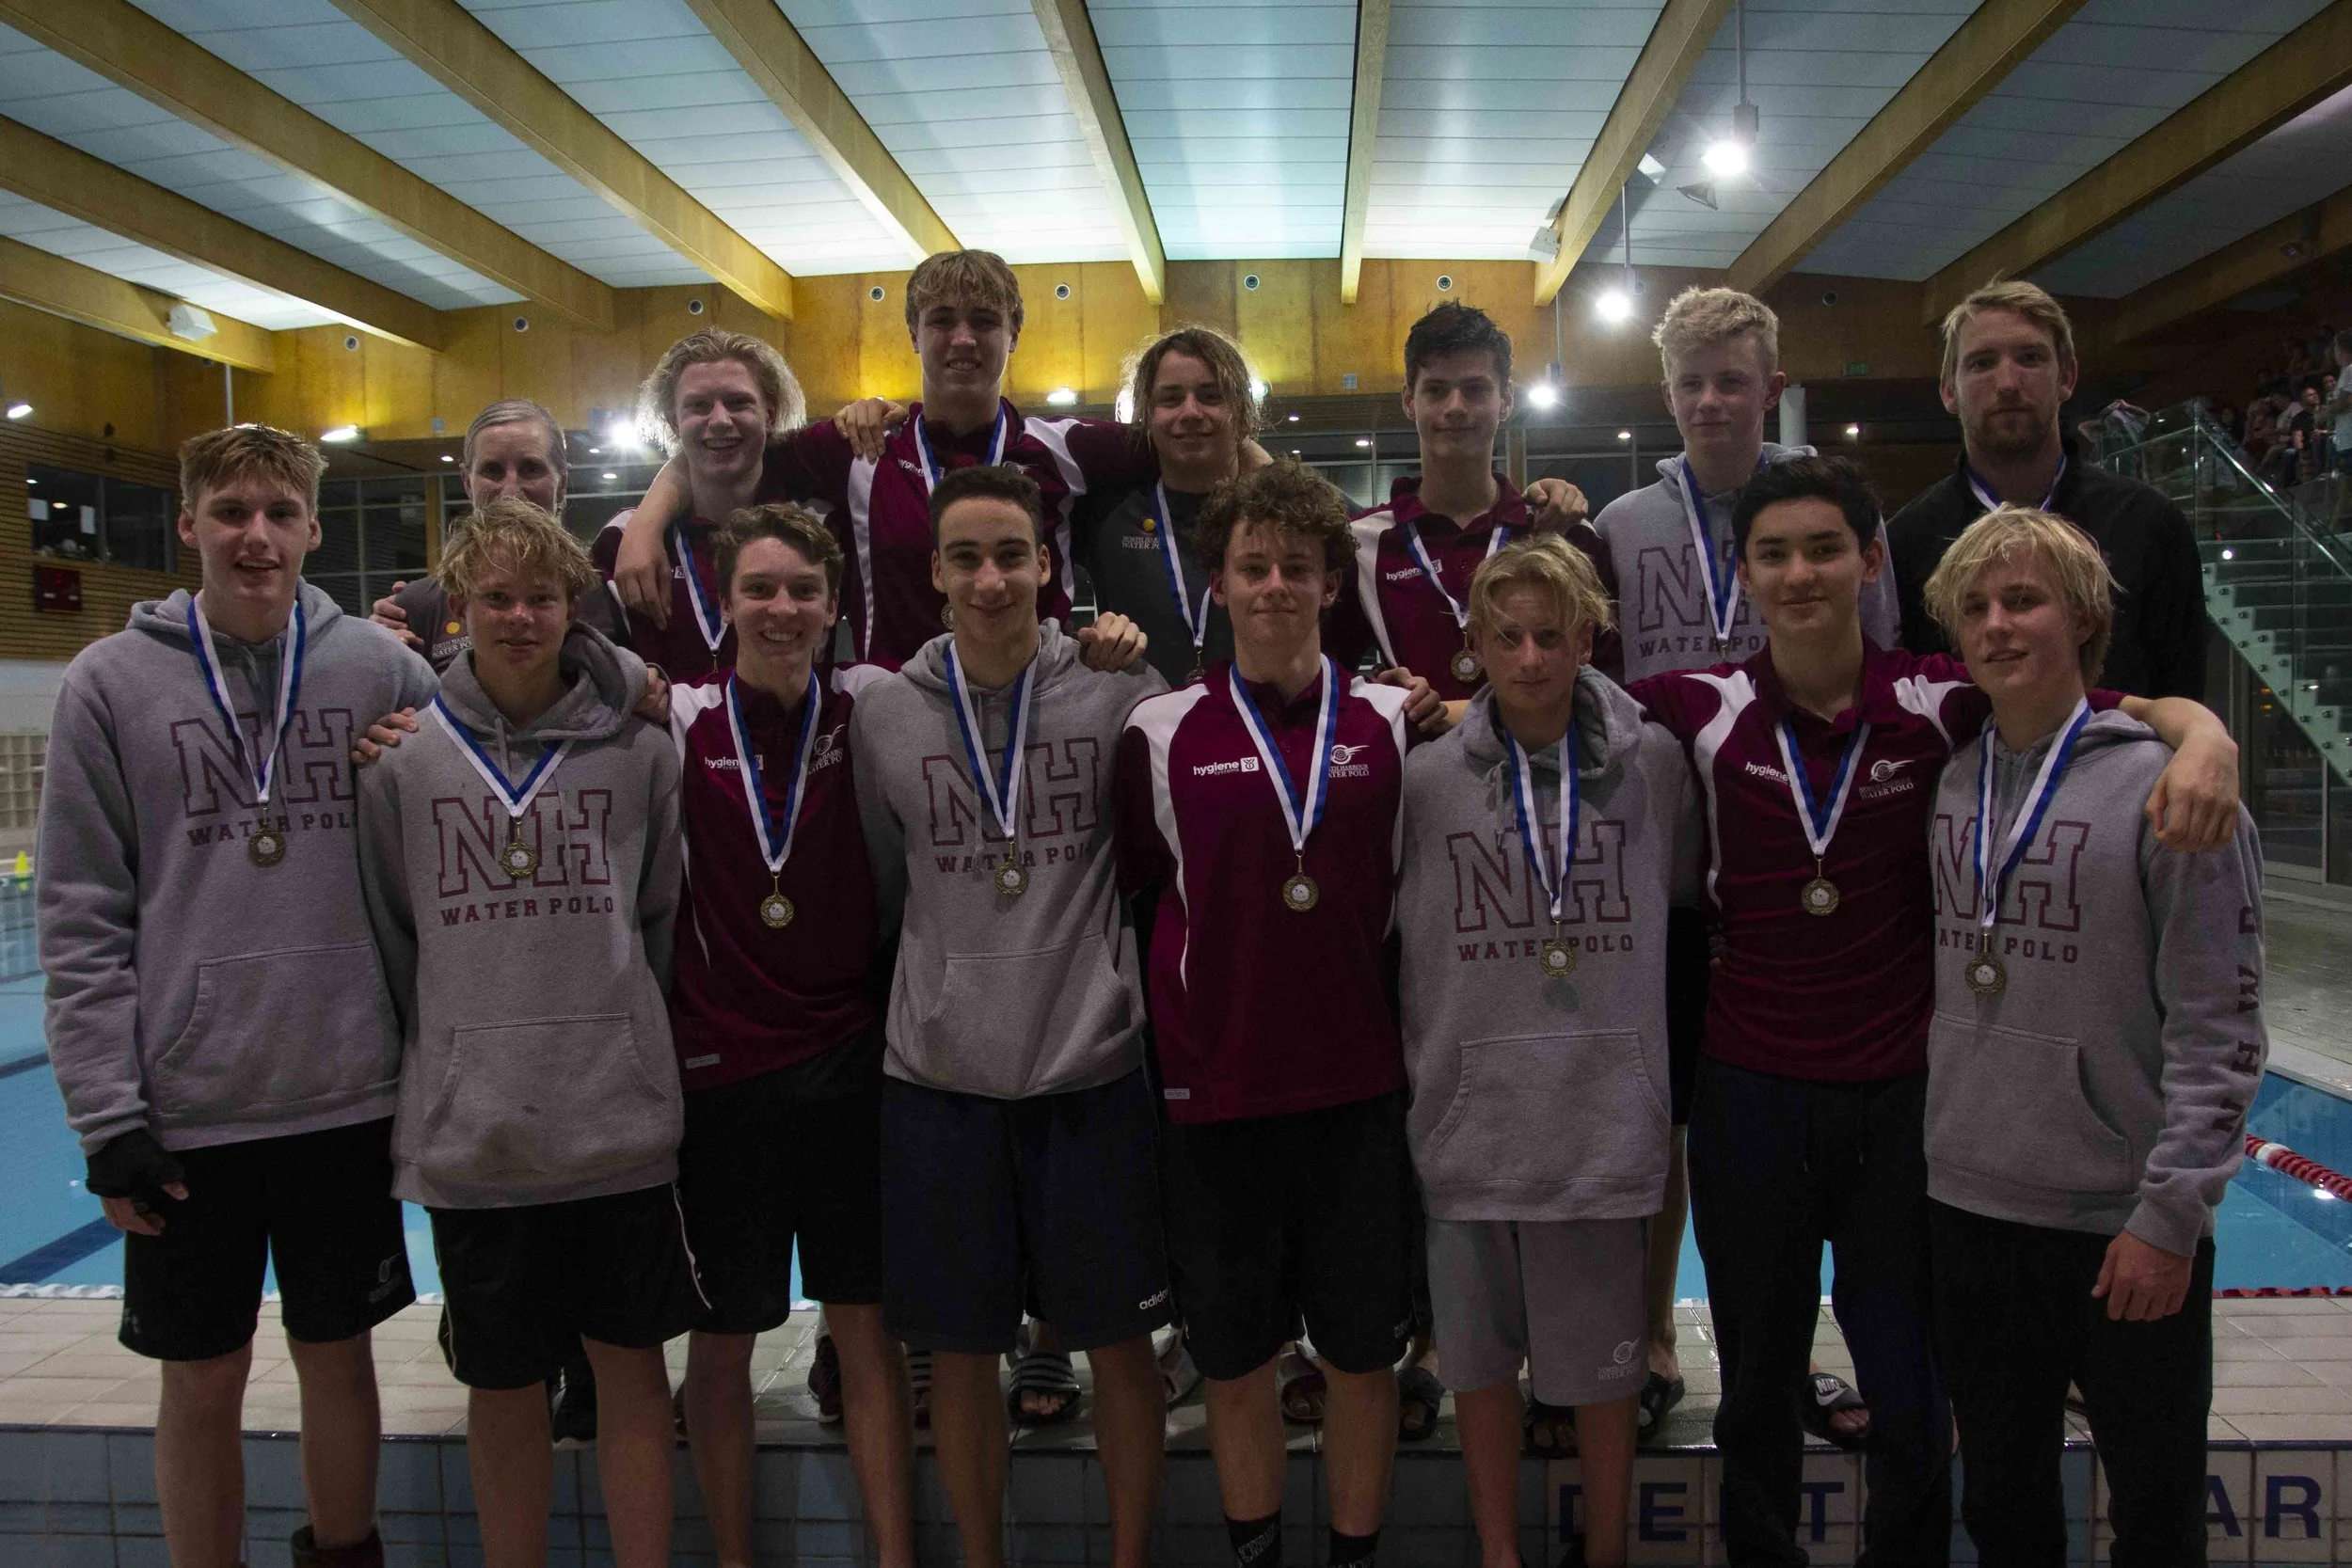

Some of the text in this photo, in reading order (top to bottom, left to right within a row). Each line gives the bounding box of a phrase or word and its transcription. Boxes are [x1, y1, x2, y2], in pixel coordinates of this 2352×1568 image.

[1386, 567, 1423, 581] hygien
[170, 708, 357, 818] NH
[705, 756, 741, 769] hygien
[1193, 761, 1240, 777] hygiene
[1745, 762, 1788, 782] hygiene
[1348, 769, 1370, 778] POLO
[922, 737, 1100, 846] NH
[1891, 782, 1915, 795] POLO
[301, 813, 351, 831] POL
[432, 789, 612, 898] NH
[935, 850, 1036, 873] WATR
[1446, 820, 1631, 933] NH
[440, 895, 613, 926] WATER POLO
[2004, 937, 2079, 964] POLO
